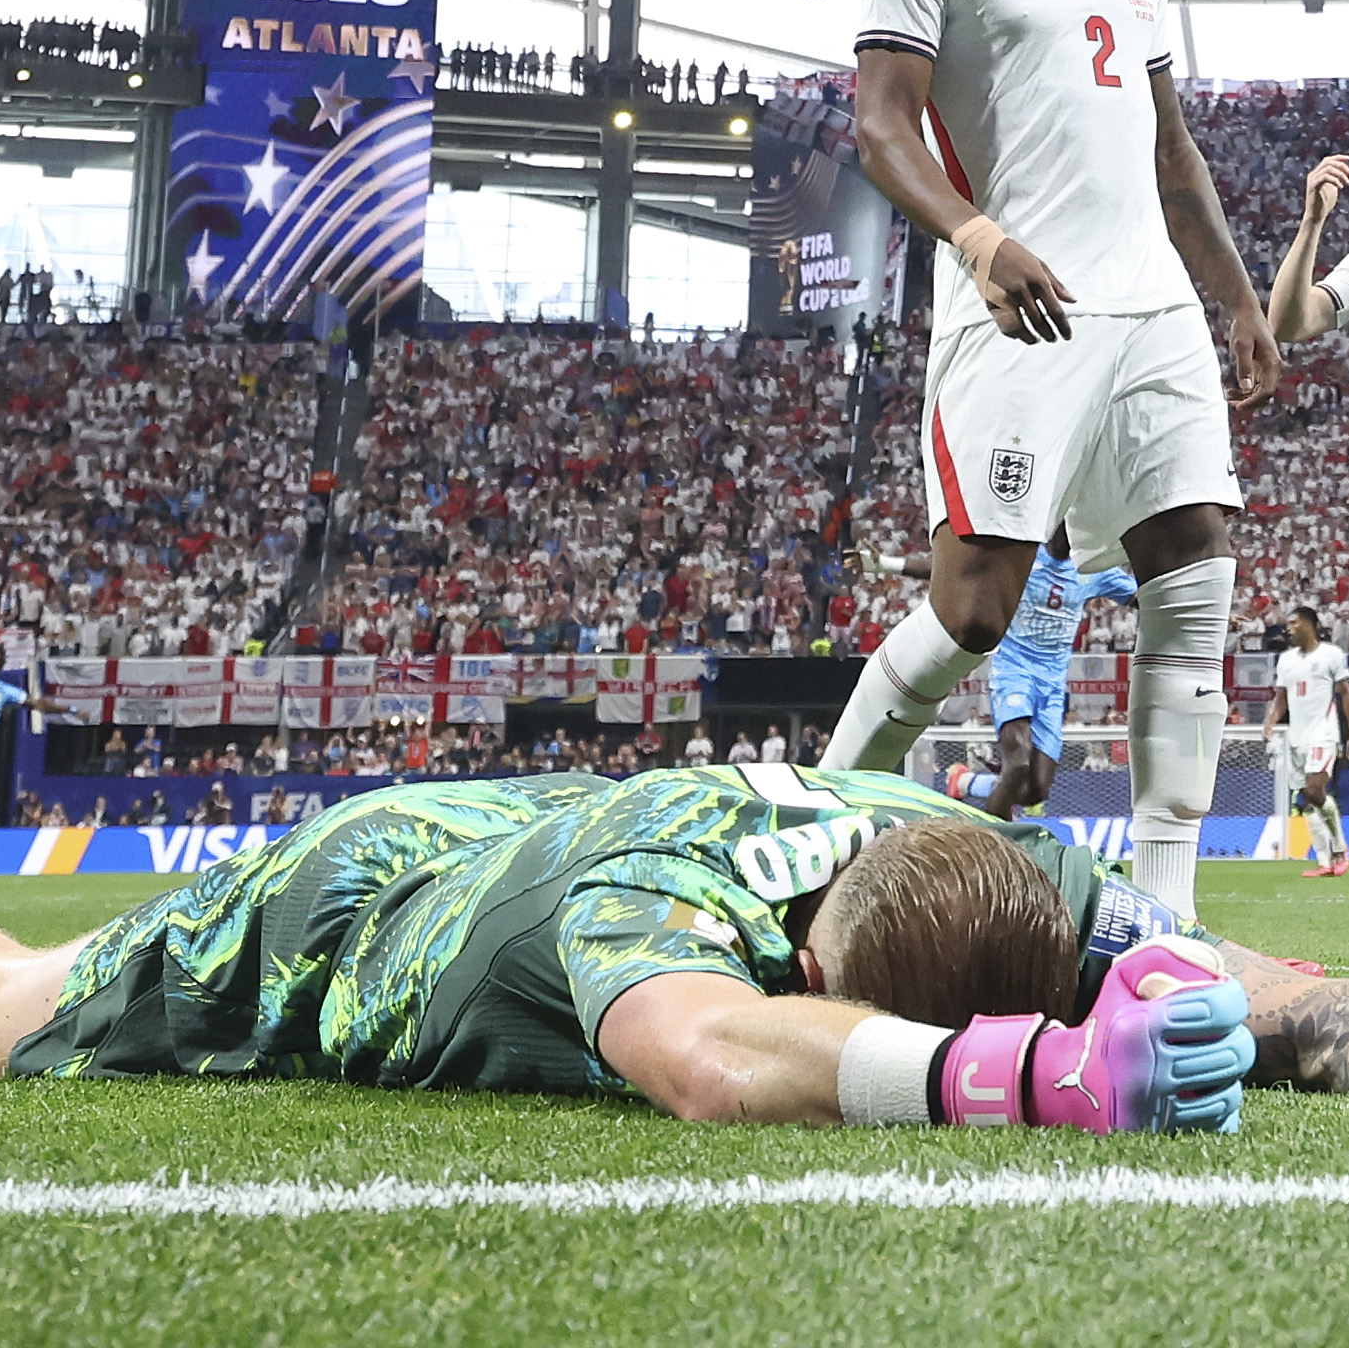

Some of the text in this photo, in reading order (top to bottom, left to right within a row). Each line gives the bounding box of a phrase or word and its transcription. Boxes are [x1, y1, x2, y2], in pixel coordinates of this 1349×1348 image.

[222, 17, 425, 61] ATLANTA
[1084, 15, 1122, 88] 2
[801, 232, 833, 259] FIFA
[800, 256, 851, 286] WORLD
[799, 287, 830, 312] CUP
[251, 792, 324, 822] FFA
[1093, 885, 1117, 939] FOOTBALL
[1108, 890, 1135, 944] UNITES
